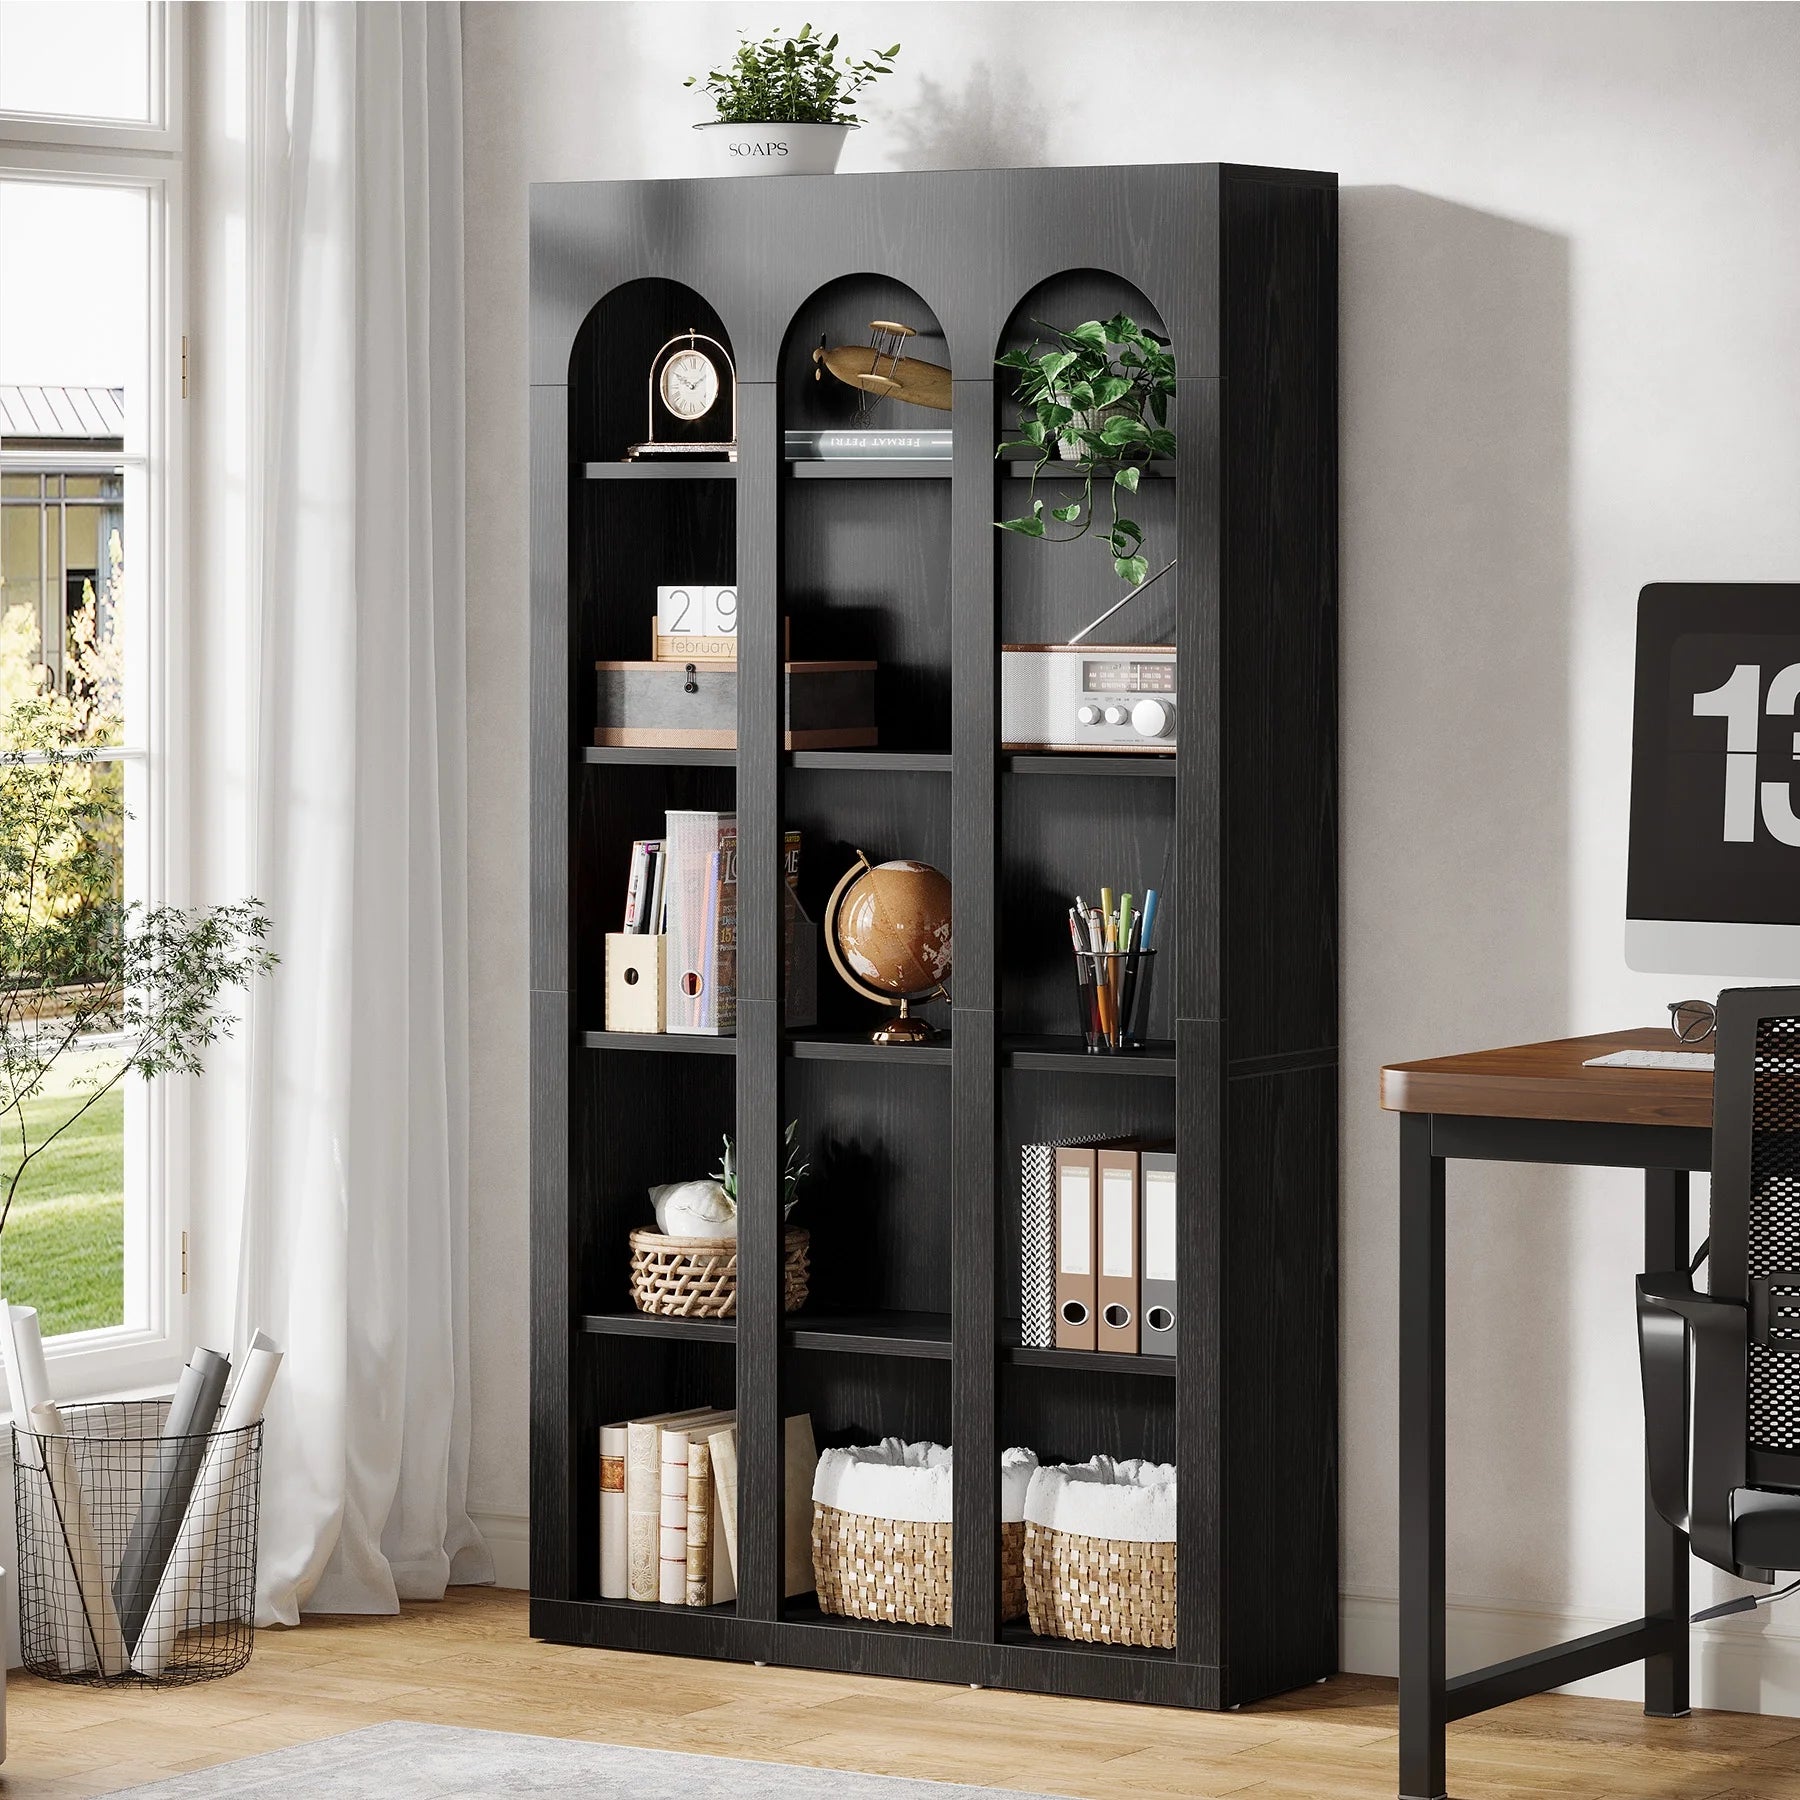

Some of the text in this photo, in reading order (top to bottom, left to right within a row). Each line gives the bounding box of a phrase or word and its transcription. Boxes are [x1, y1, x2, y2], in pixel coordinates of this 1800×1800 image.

[728, 142, 789, 157] SOAPS
[831, 438, 921, 448] FERMAT PETRI
[671, 637, 735, 658] february
